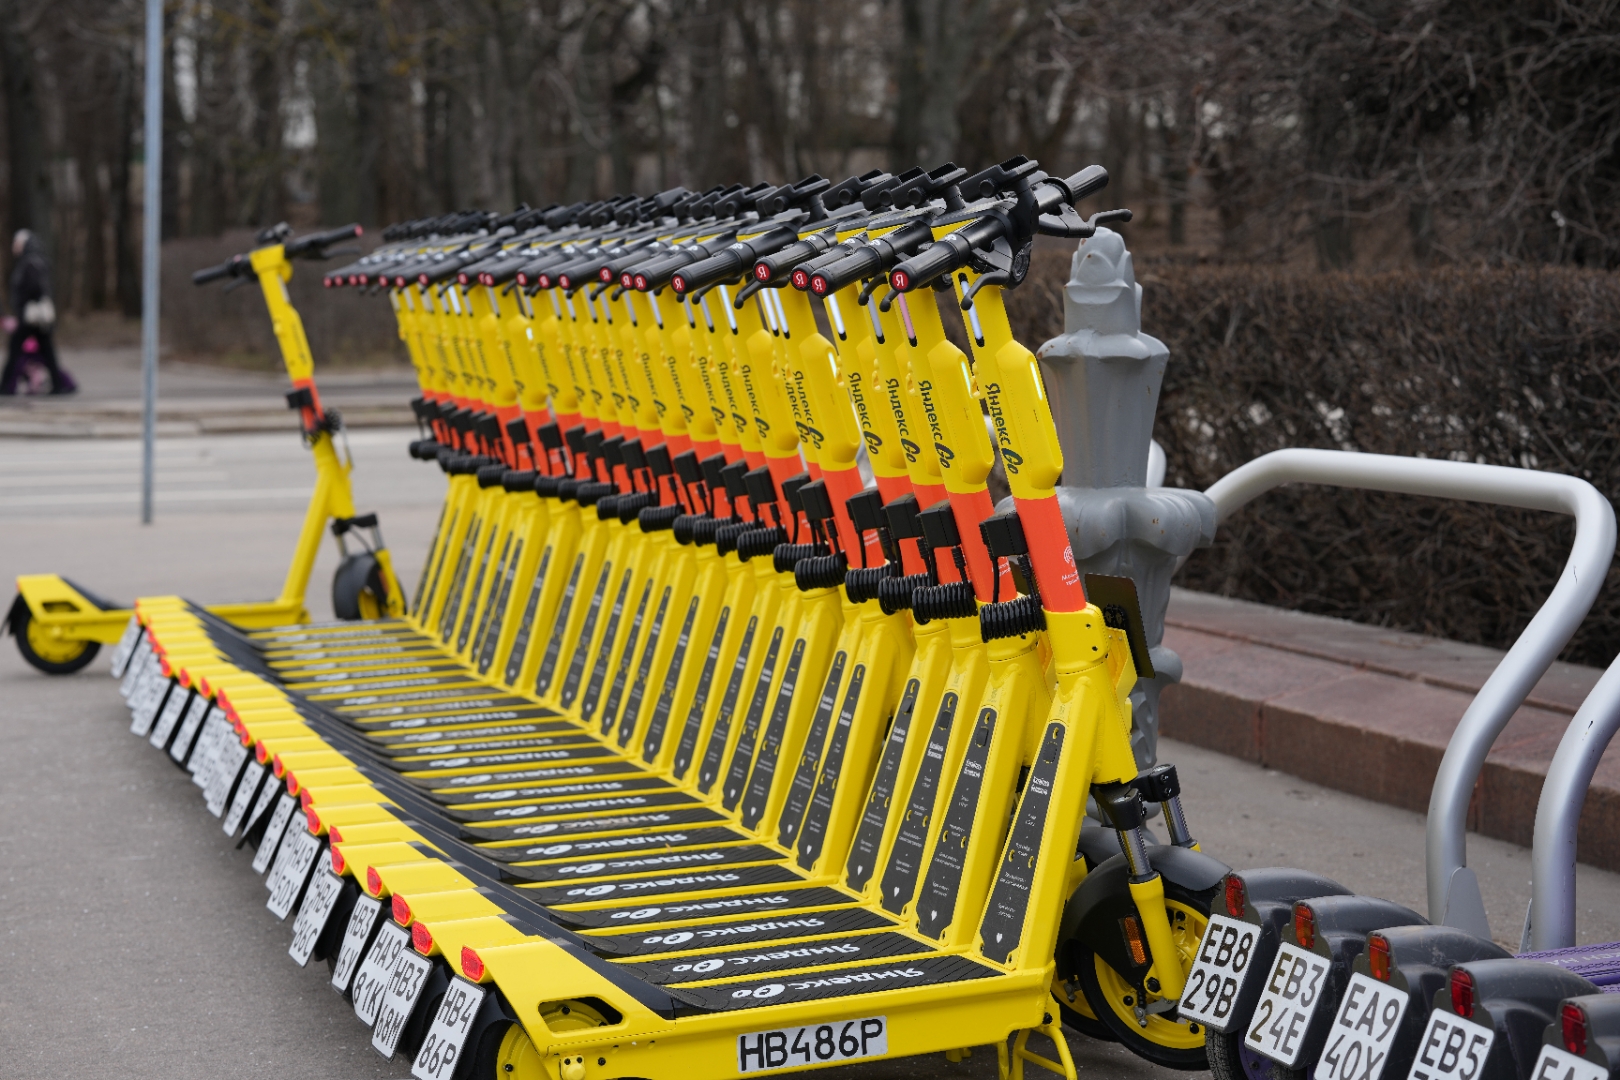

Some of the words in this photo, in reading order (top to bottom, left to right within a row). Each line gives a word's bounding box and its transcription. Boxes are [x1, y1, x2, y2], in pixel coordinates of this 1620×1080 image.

[740, 364, 760, 416] Яндекс
[793, 370, 814, 424] Яндекс
[848, 372, 872, 433] Яндекс
[886, 378, 910, 436] Яндекс
[918, 380, 944, 442] Яндекс
[985, 382, 1011, 452] Яндекс
[574, 833, 688, 850] Яндекс
[608, 851, 724, 869] Яндекс
[620, 872, 740, 891] Яндекс
[664, 894, 790, 916] Яндекс
[696, 918, 826, 938] Яндекс
[730, 942, 861, 968] Яндекс
[788, 966, 926, 991] Яндекс
